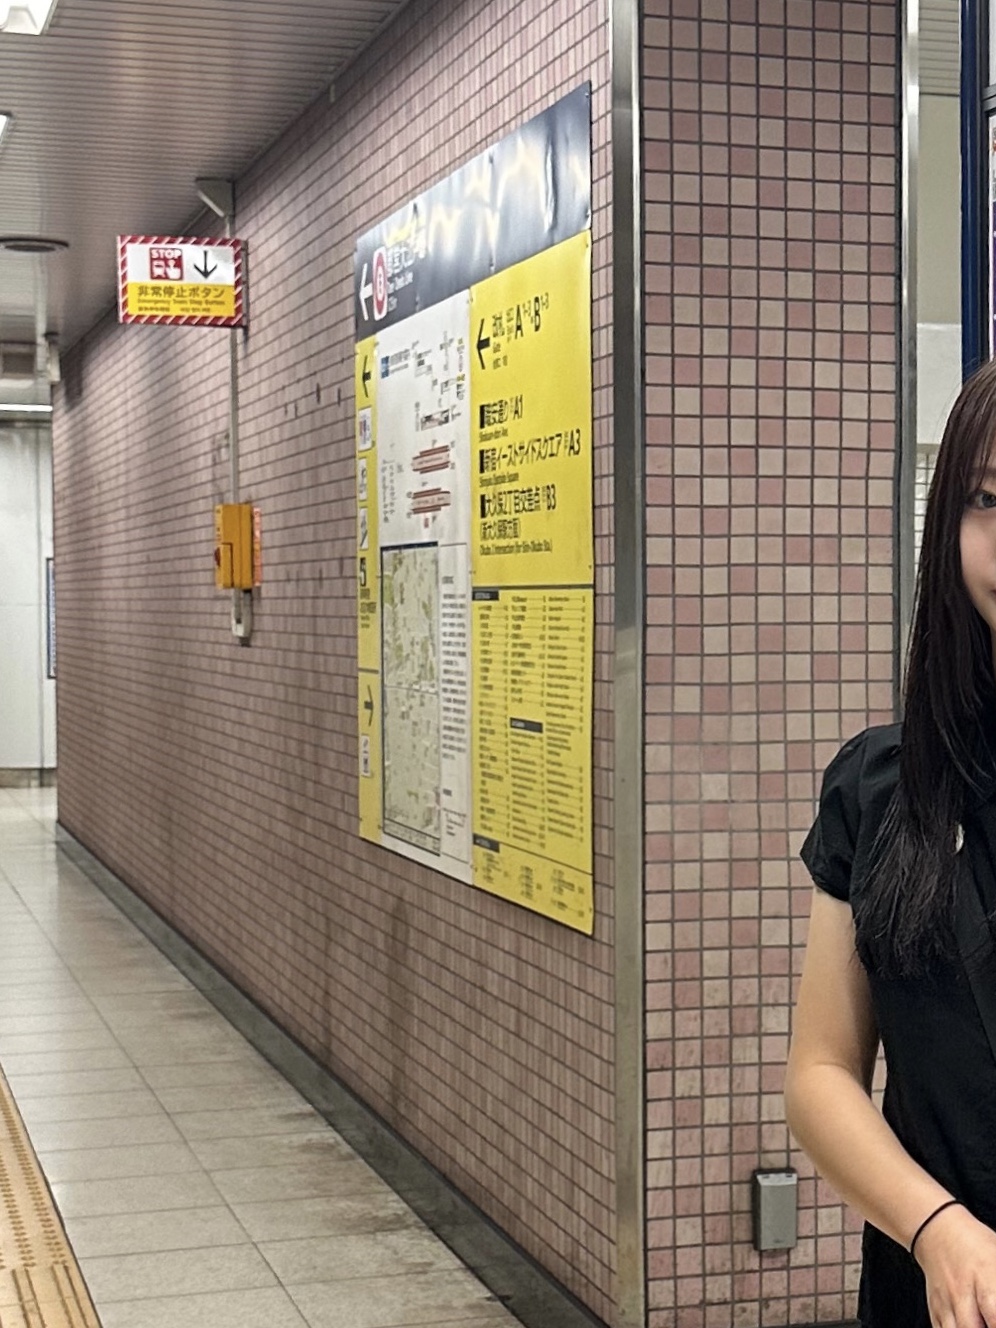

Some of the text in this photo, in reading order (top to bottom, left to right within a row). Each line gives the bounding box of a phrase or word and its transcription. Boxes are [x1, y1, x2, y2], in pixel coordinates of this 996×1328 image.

[151, 248, 182, 259] STOP
[137, 285, 225, 299] 非常停止ボタン
[567, 428, 581, 457] A3
